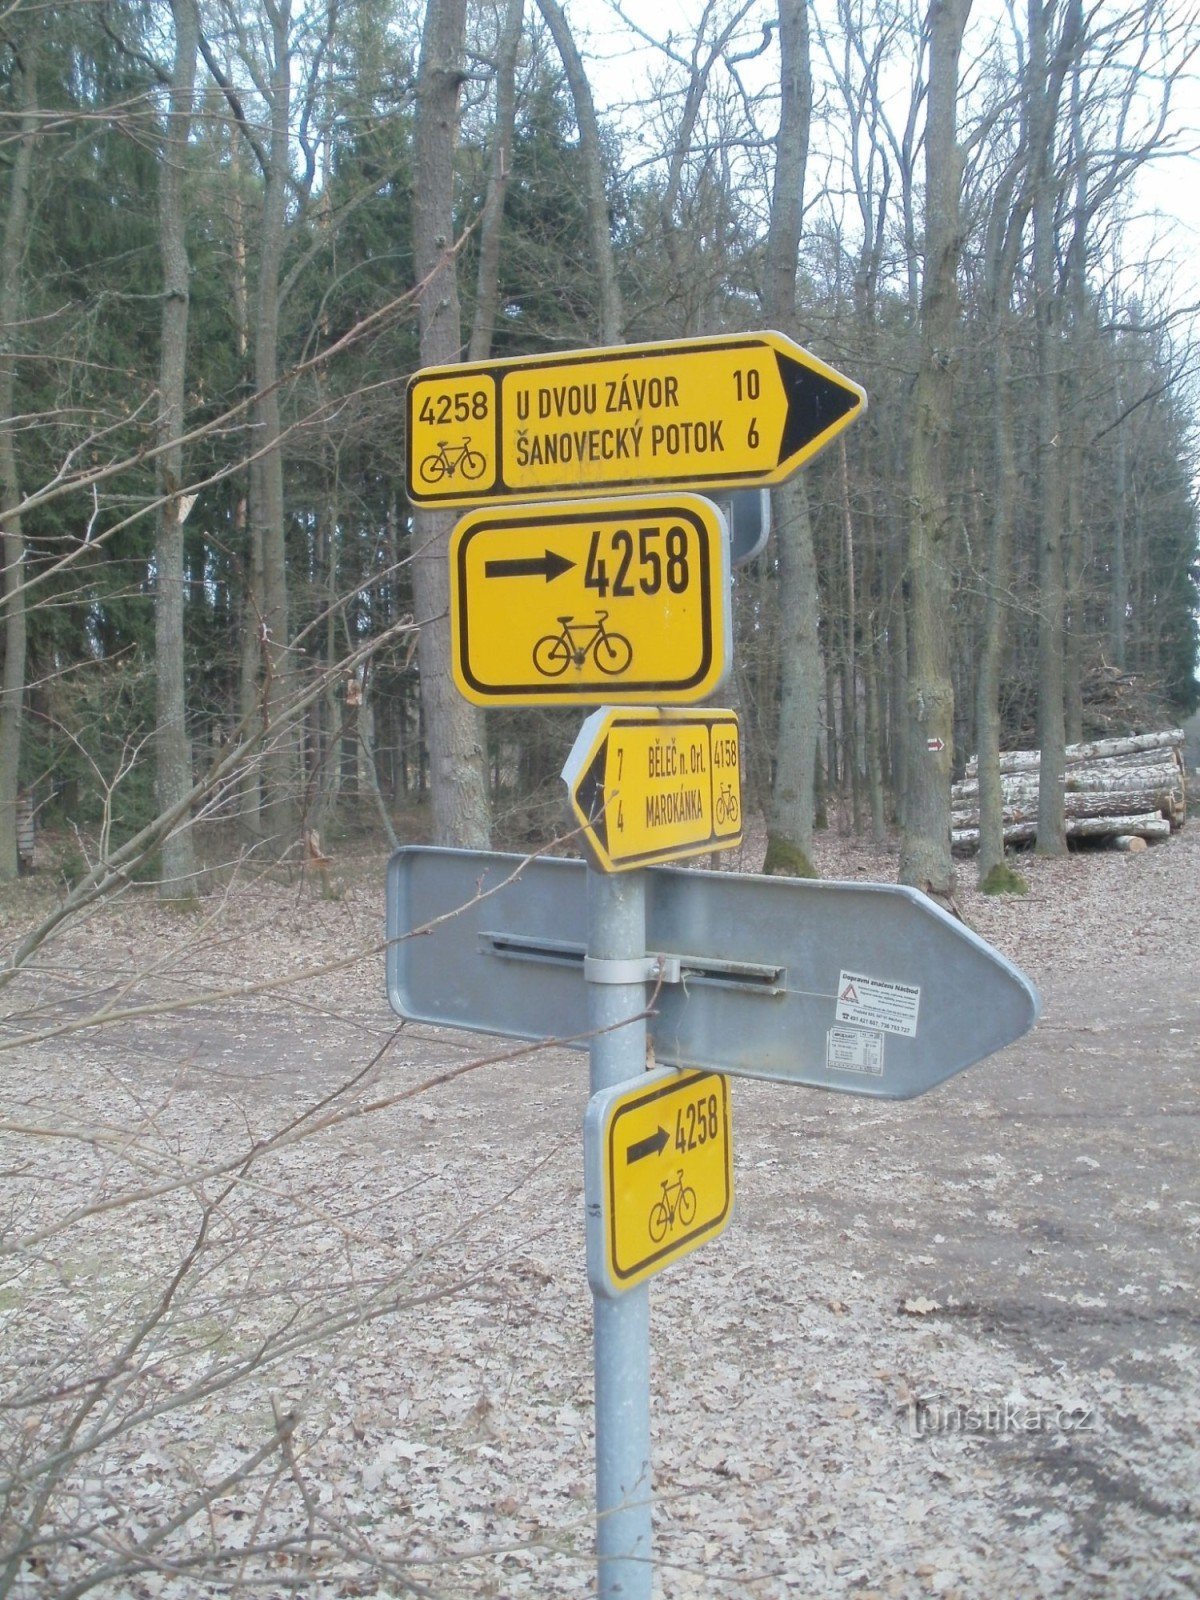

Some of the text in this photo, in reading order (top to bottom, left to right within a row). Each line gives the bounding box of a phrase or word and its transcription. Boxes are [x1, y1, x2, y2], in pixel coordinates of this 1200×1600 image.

[516, 373, 679, 420] U DVOU ZÁVOR
[732, 369, 760, 402] 10
[419, 390, 488, 426] 4258
[516, 418, 725, 467] ŠANOVECKÝ POTOK
[747, 417, 760, 449] 6
[584, 526, 689, 598] 4258
[617, 748, 624, 781] 7
[648, 737, 706, 778] BĚLEČ n. Orl.
[714, 740, 737, 768] 4158
[617, 800, 624, 833] 4
[646, 784, 704, 828] MAROKÁNKA
[675, 1094, 718, 1154] 4258
